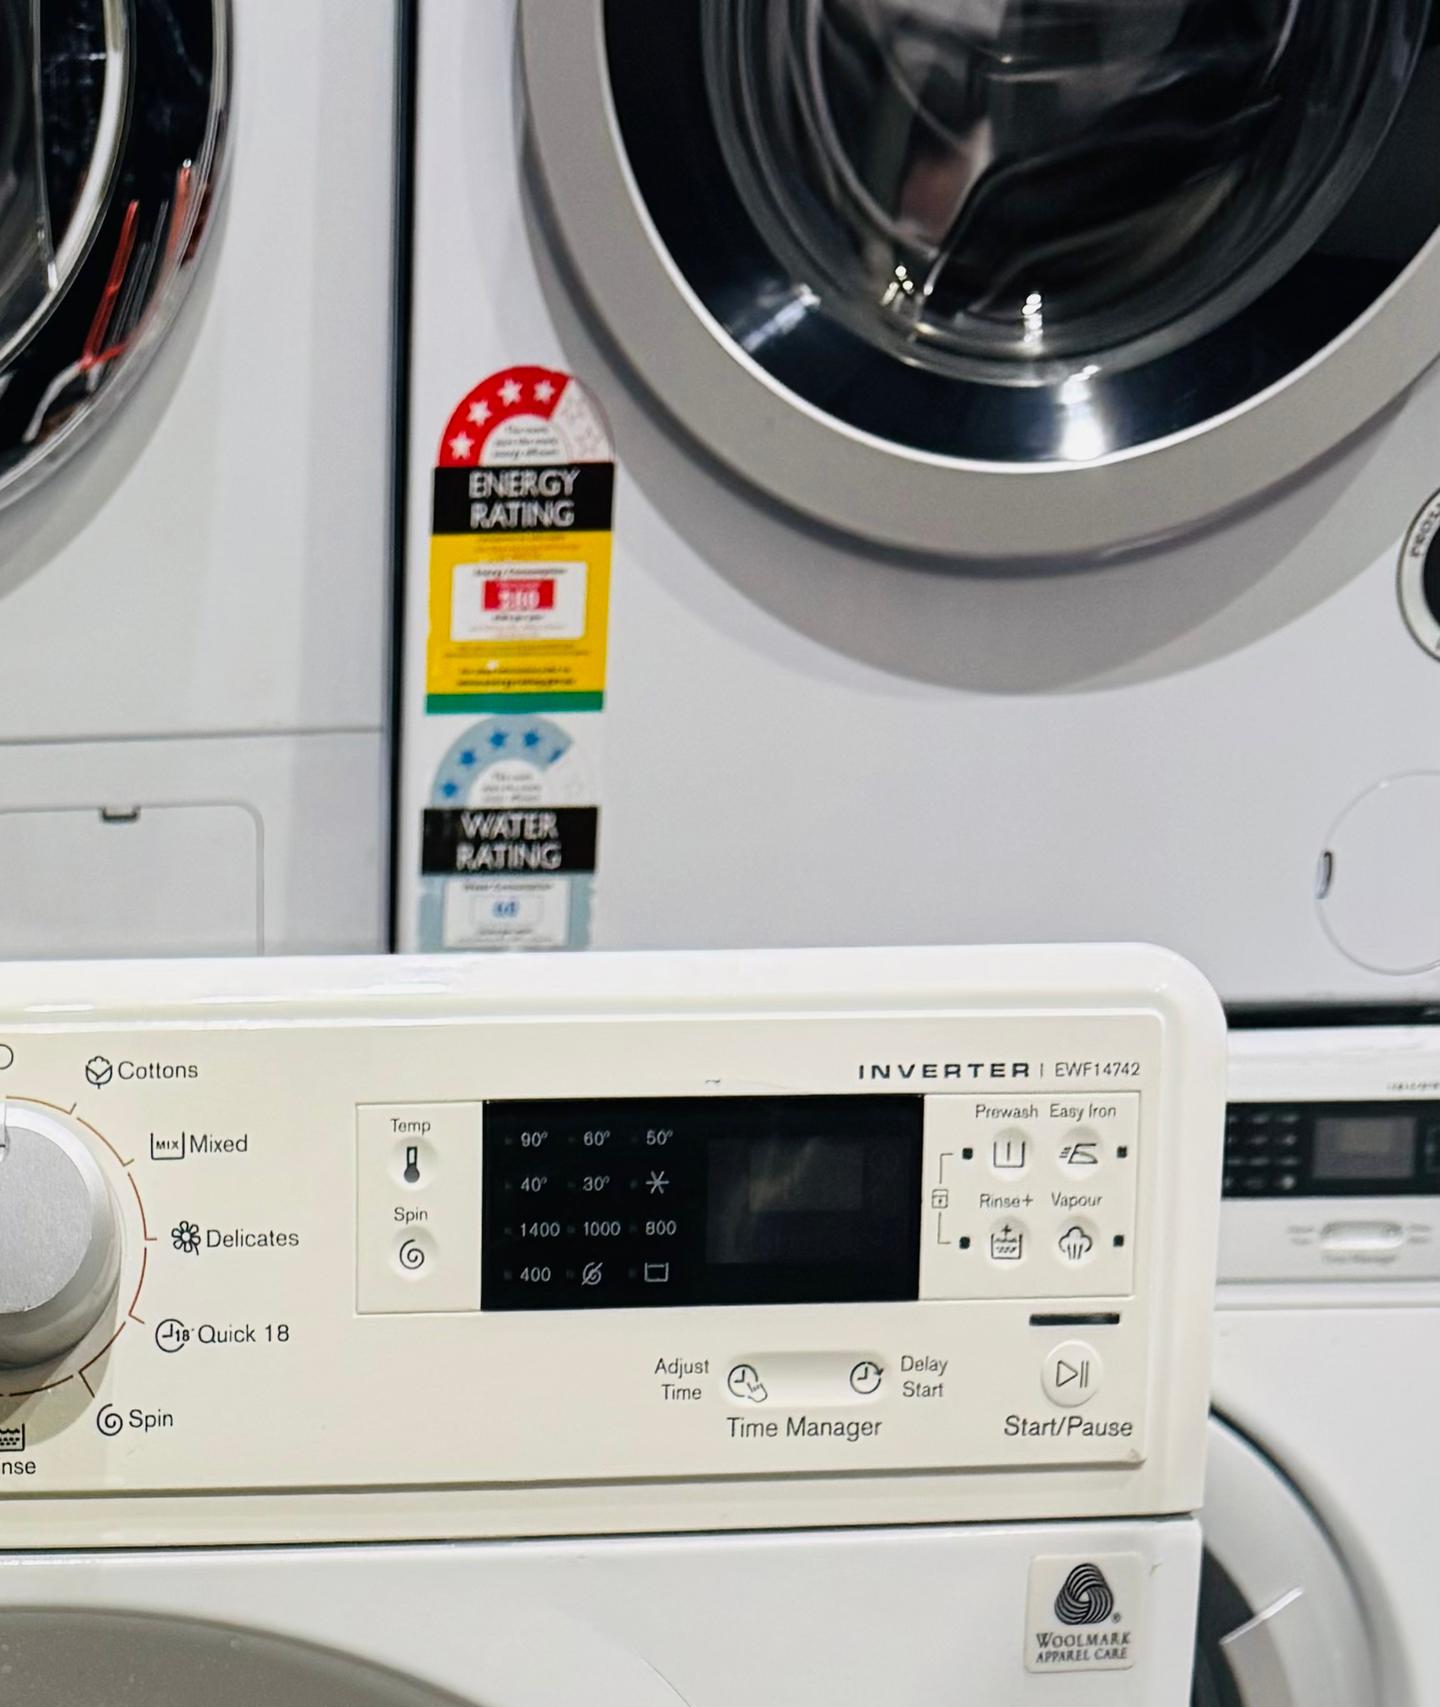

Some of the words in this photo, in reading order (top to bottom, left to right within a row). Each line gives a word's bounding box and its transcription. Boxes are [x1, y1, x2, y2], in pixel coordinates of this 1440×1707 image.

[469, 468, 581, 499] ENERGY
[470, 501, 575, 529] RATING
[461, 812, 558, 840] WATER
[456, 842, 562, 871] RATING
[118, 1061, 198, 1080] Cottons
[859, 1063, 1030, 1079] INVERTER
[1055, 1062, 1141, 1077] EWF14742
[975, 1103, 1038, 1119] Prewash
[1049, 1103, 1084, 1121] Easy
[1088, 1103, 1117, 1117] Iron
[390, 1118, 431, 1135] Temp
[156, 1140, 179, 1150] MIX
[190, 1133, 248, 1153] Mixed
[979, 1193, 1034, 1208] Rinse+
[1051, 1192, 1103, 1211] Vapour
[394, 1207, 428, 1224] Spin
[520, 1221, 560, 1238] 1400
[583, 1220, 621, 1237] 1000
[645, 1219, 677, 1236] 800
[206, 1229, 300, 1248] Delicates
[520, 1266, 551, 1283] 400
[198, 1324, 256, 1344] Quick
[264, 1324, 290, 1342] 18
[655, 1358, 709, 1378] Adjust
[900, 1355, 948, 1375] Delay
[661, 1383, 702, 1401] Time
[902, 1381, 944, 1398] Start
[128, 1410, 174, 1430] Spin
[726, 1417, 777, 1438] Time
[786, 1417, 882, 1441] Manager
[1004, 1416, 1133, 1437] Start/Pause
[1036, 1632, 1132, 1649] WOOLMARK
[1036, 1649, 1090, 1664] APPAREL
[1094, 1648, 1128, 1660] CARE
